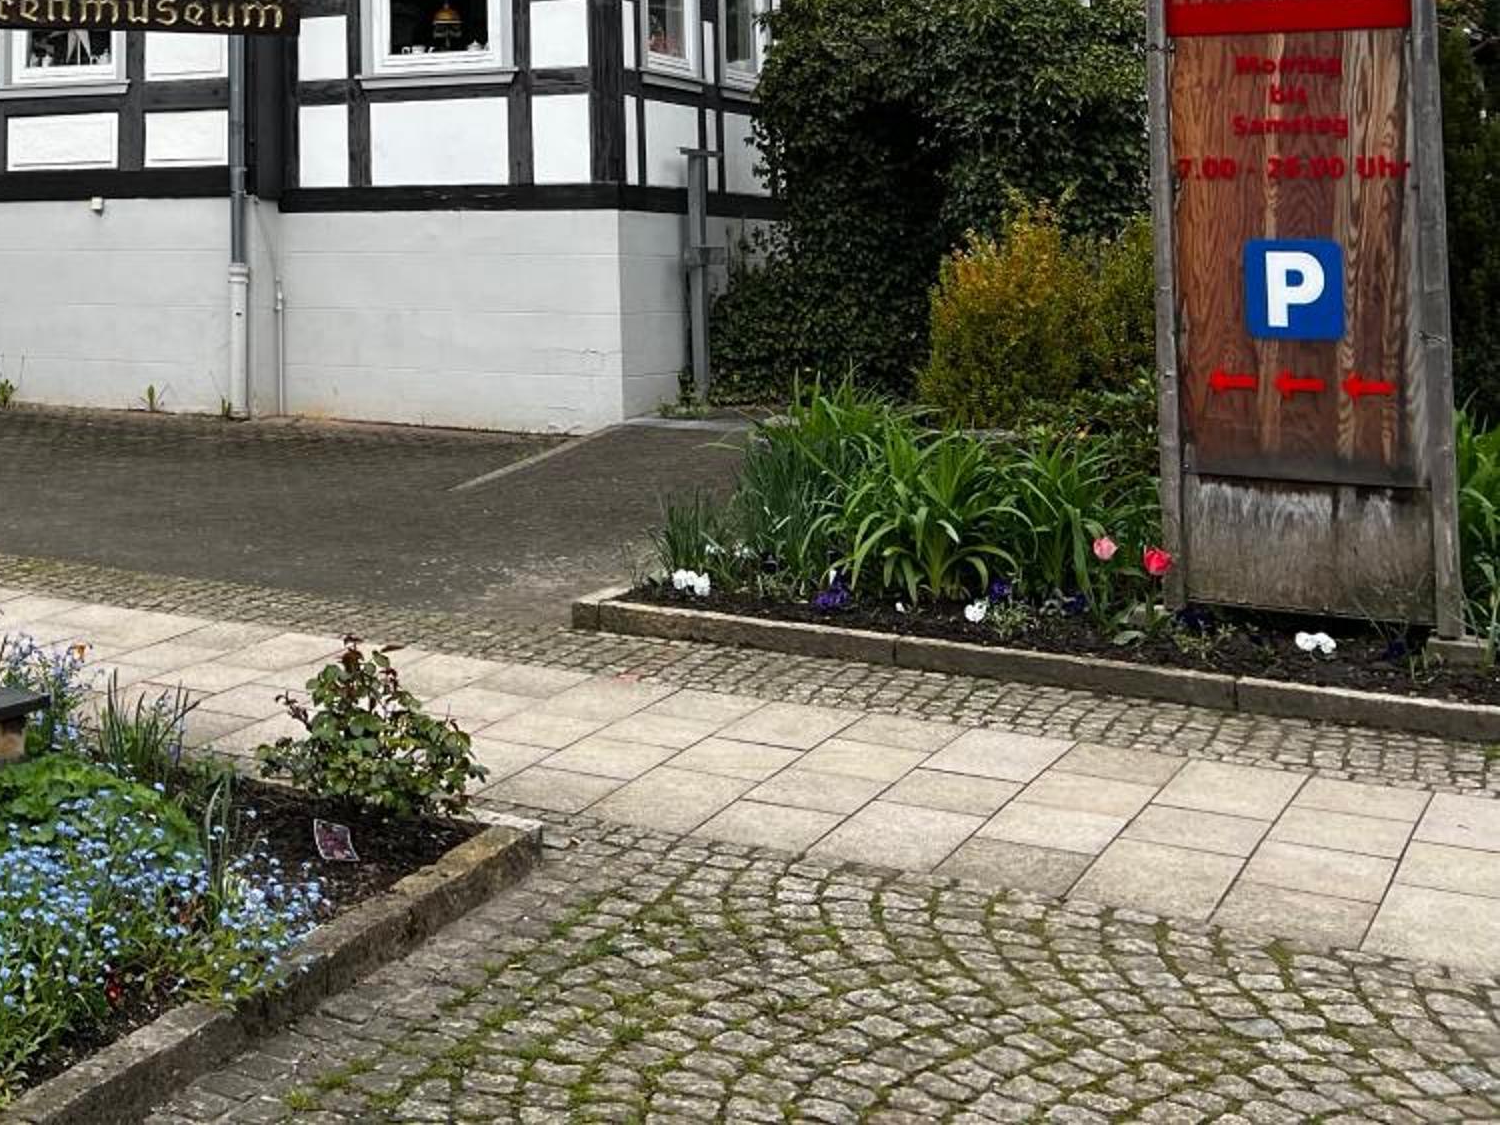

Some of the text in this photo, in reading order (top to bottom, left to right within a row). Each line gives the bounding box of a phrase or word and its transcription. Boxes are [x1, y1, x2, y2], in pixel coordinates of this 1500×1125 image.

[1235, 54, 1342, 77] Montag
[1270, 83, 1308, 105] bis
[1232, 114, 1348, 139] Samstag
[1176, 157, 1237, 181] 7.00
[1356, 154, 1411, 181] Uhr
[1266, 250, 1325, 328] P
